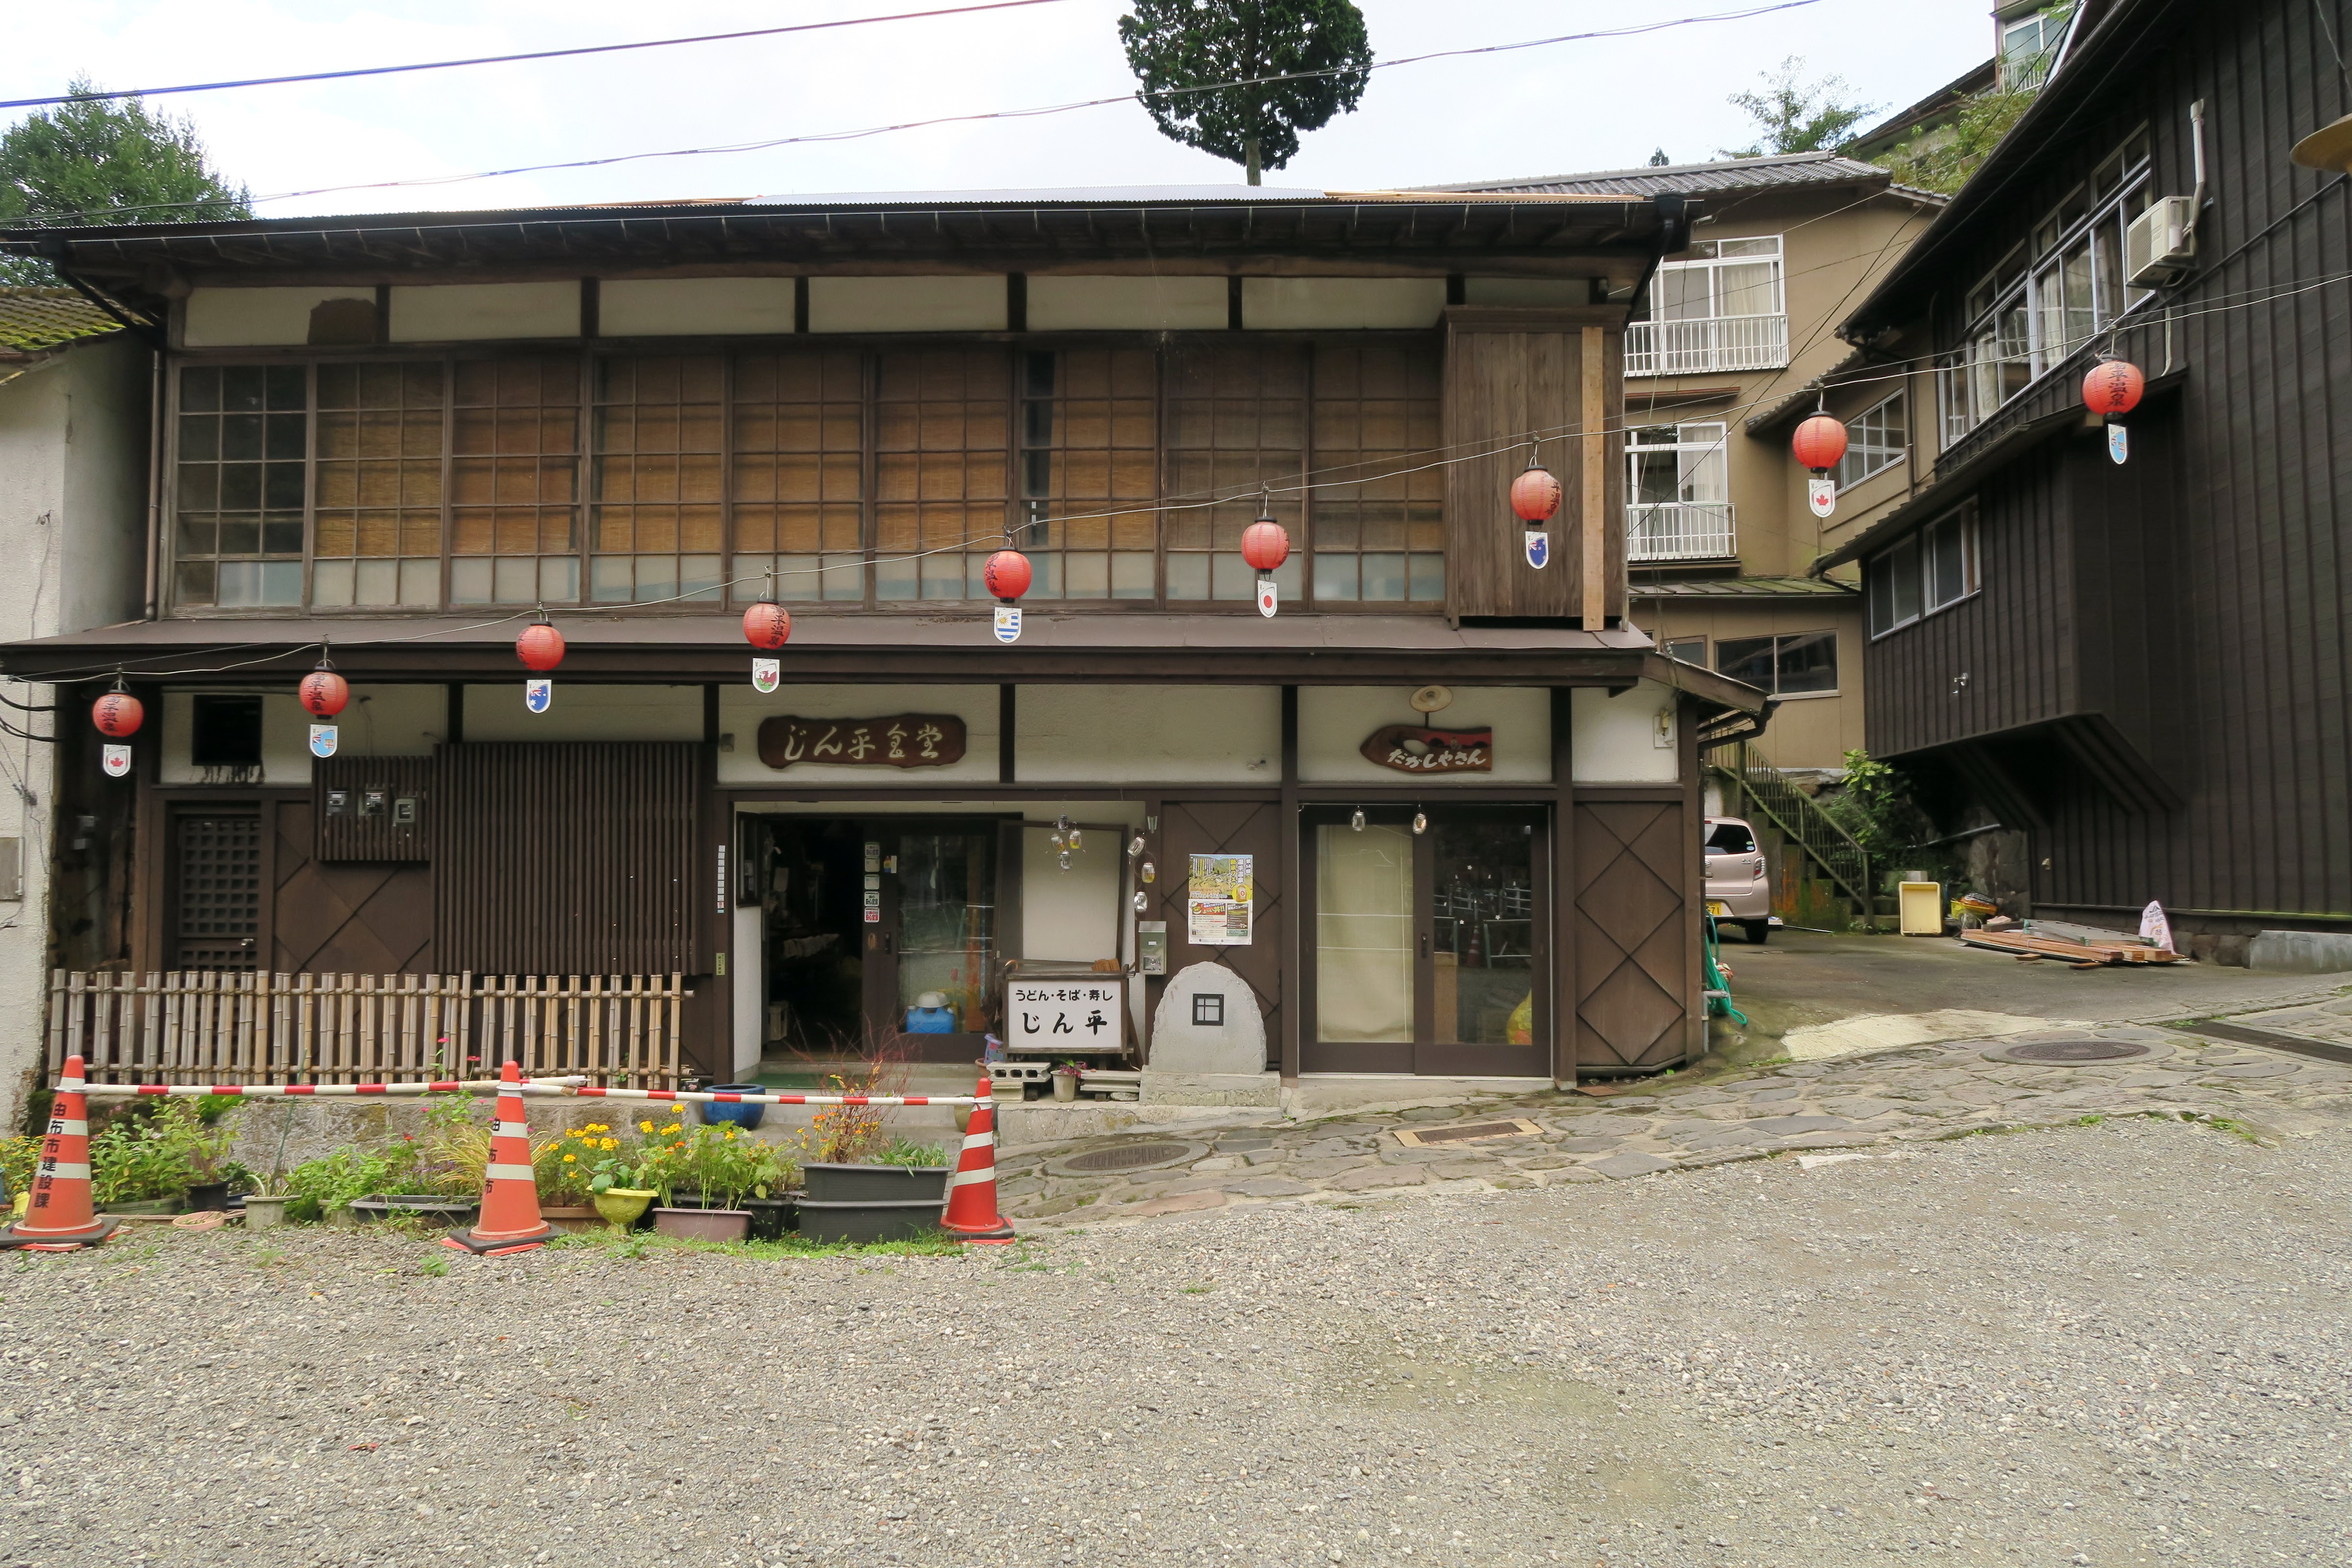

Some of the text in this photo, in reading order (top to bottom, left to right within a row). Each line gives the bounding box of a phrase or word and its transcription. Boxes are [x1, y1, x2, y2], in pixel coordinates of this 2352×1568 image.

[2106, 363, 2128, 406] 湯平温泉
[767, 605, 786, 646] 湯平温泉
[784, 723, 943, 761] じん平食堂
[1387, 748, 1487, 769] だがしやさん
[1016, 989, 1113, 1001] うどん・そば・寿し
[1022, 1009, 1107, 1036] じん平
[33, 1102, 67, 1209] 由布市建設課
